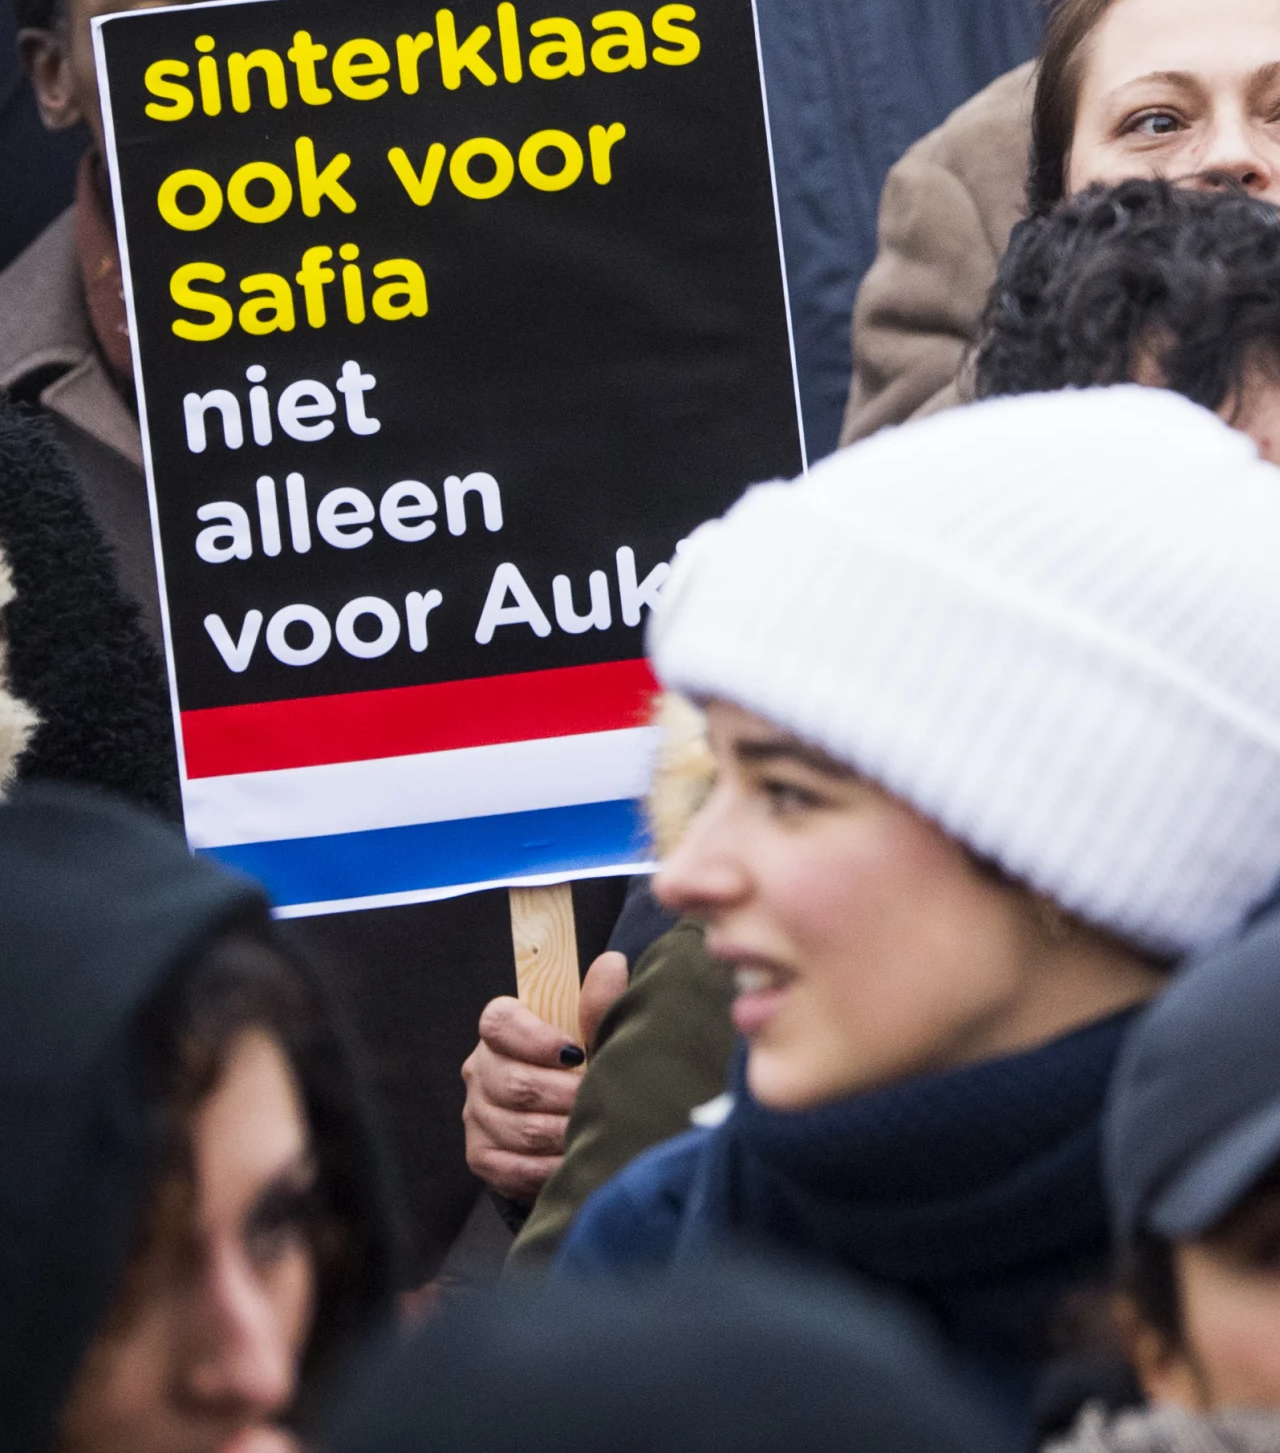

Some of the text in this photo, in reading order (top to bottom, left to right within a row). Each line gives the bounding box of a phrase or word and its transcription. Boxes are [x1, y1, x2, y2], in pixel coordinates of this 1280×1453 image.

[144, 2, 700, 121] sinterklaas
[158, 122, 626, 231] ook voor
[170, 243, 428, 341] Safia
[183, 360, 381, 453] niet
[196, 472, 503, 563] alleen
[204, 539, 688, 672] voor Auk
